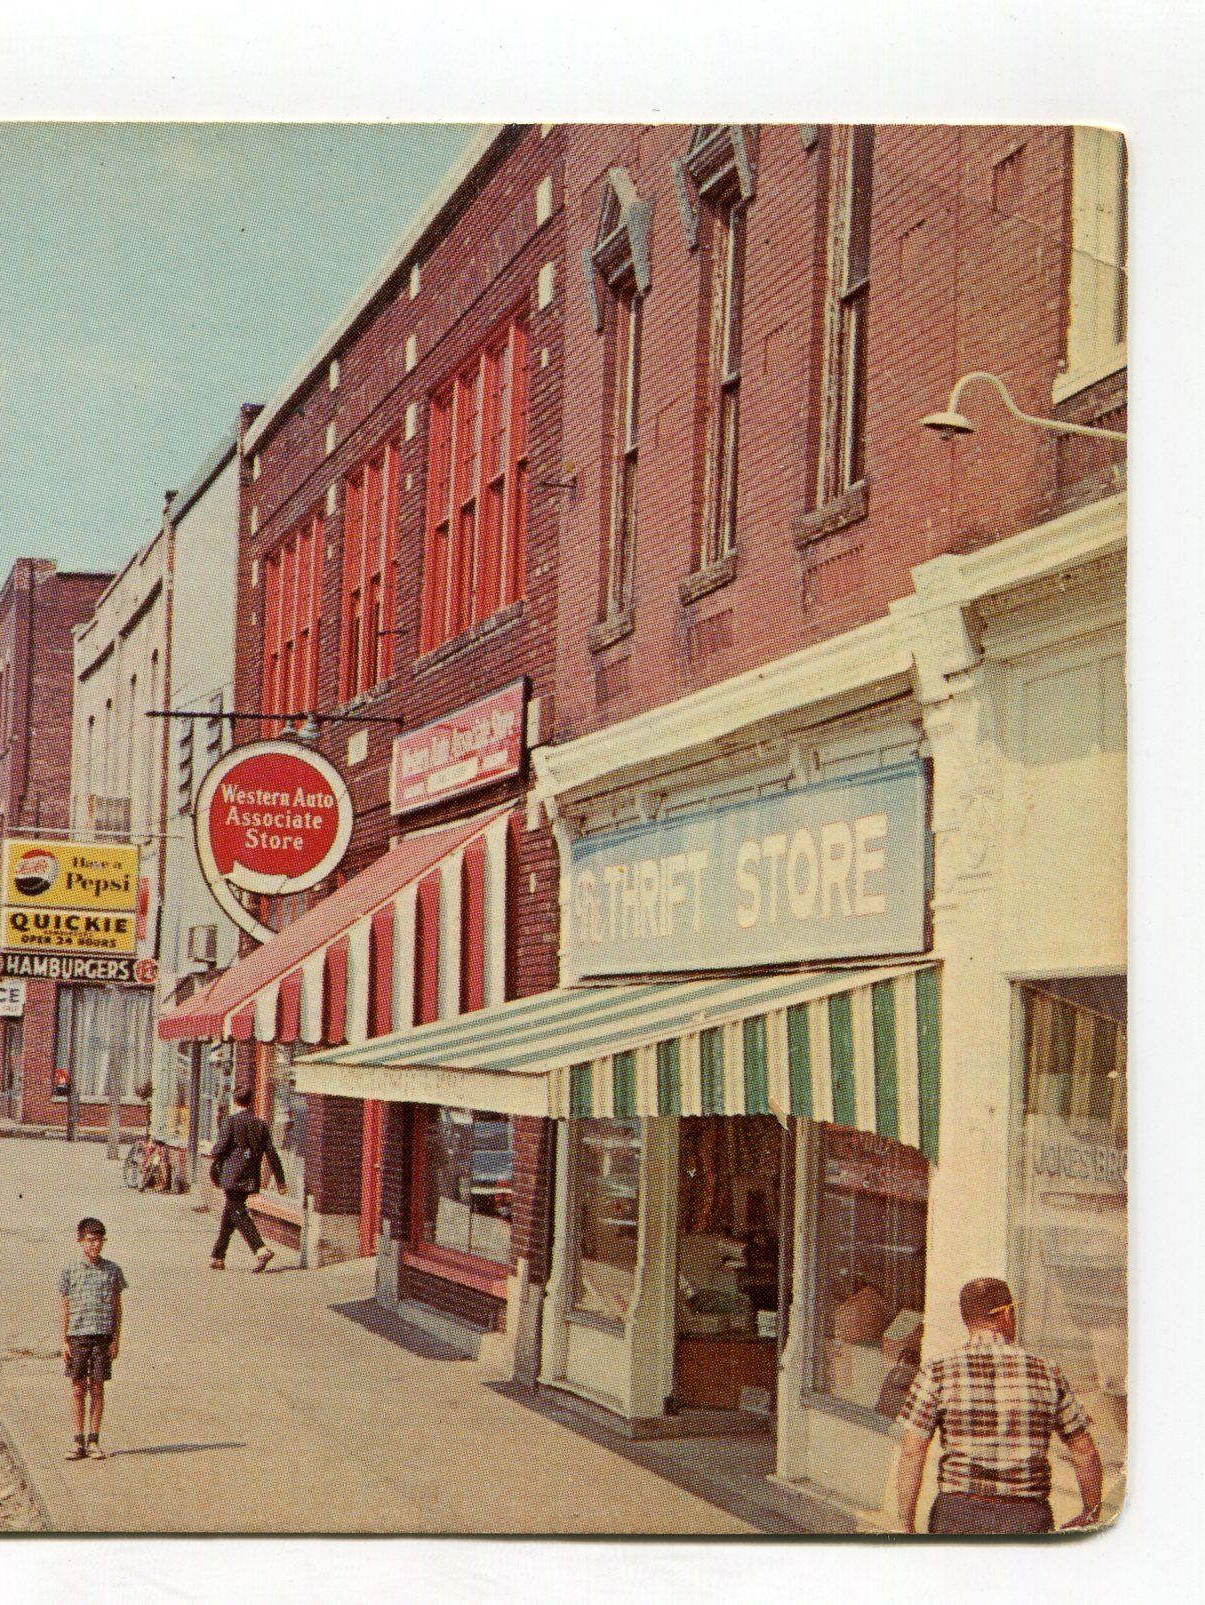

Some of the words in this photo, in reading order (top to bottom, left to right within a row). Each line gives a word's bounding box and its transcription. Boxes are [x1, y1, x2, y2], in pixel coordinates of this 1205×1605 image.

[220, 783, 290, 807] Western
[293, 786, 335, 809] Auto
[225, 805, 323, 830] Associate
[244, 827, 304, 851] Store
[72, 856, 109, 870] Have
[66, 871, 131, 897] Pepsi
[603, 849, 710, 942] THRIFT
[735, 811, 889, 929] STORE
[9, 911, 129, 934] QUICKIE
[20, 933, 51, 945] OPEN
[6, 955, 130, 980] HAMBURGERS
